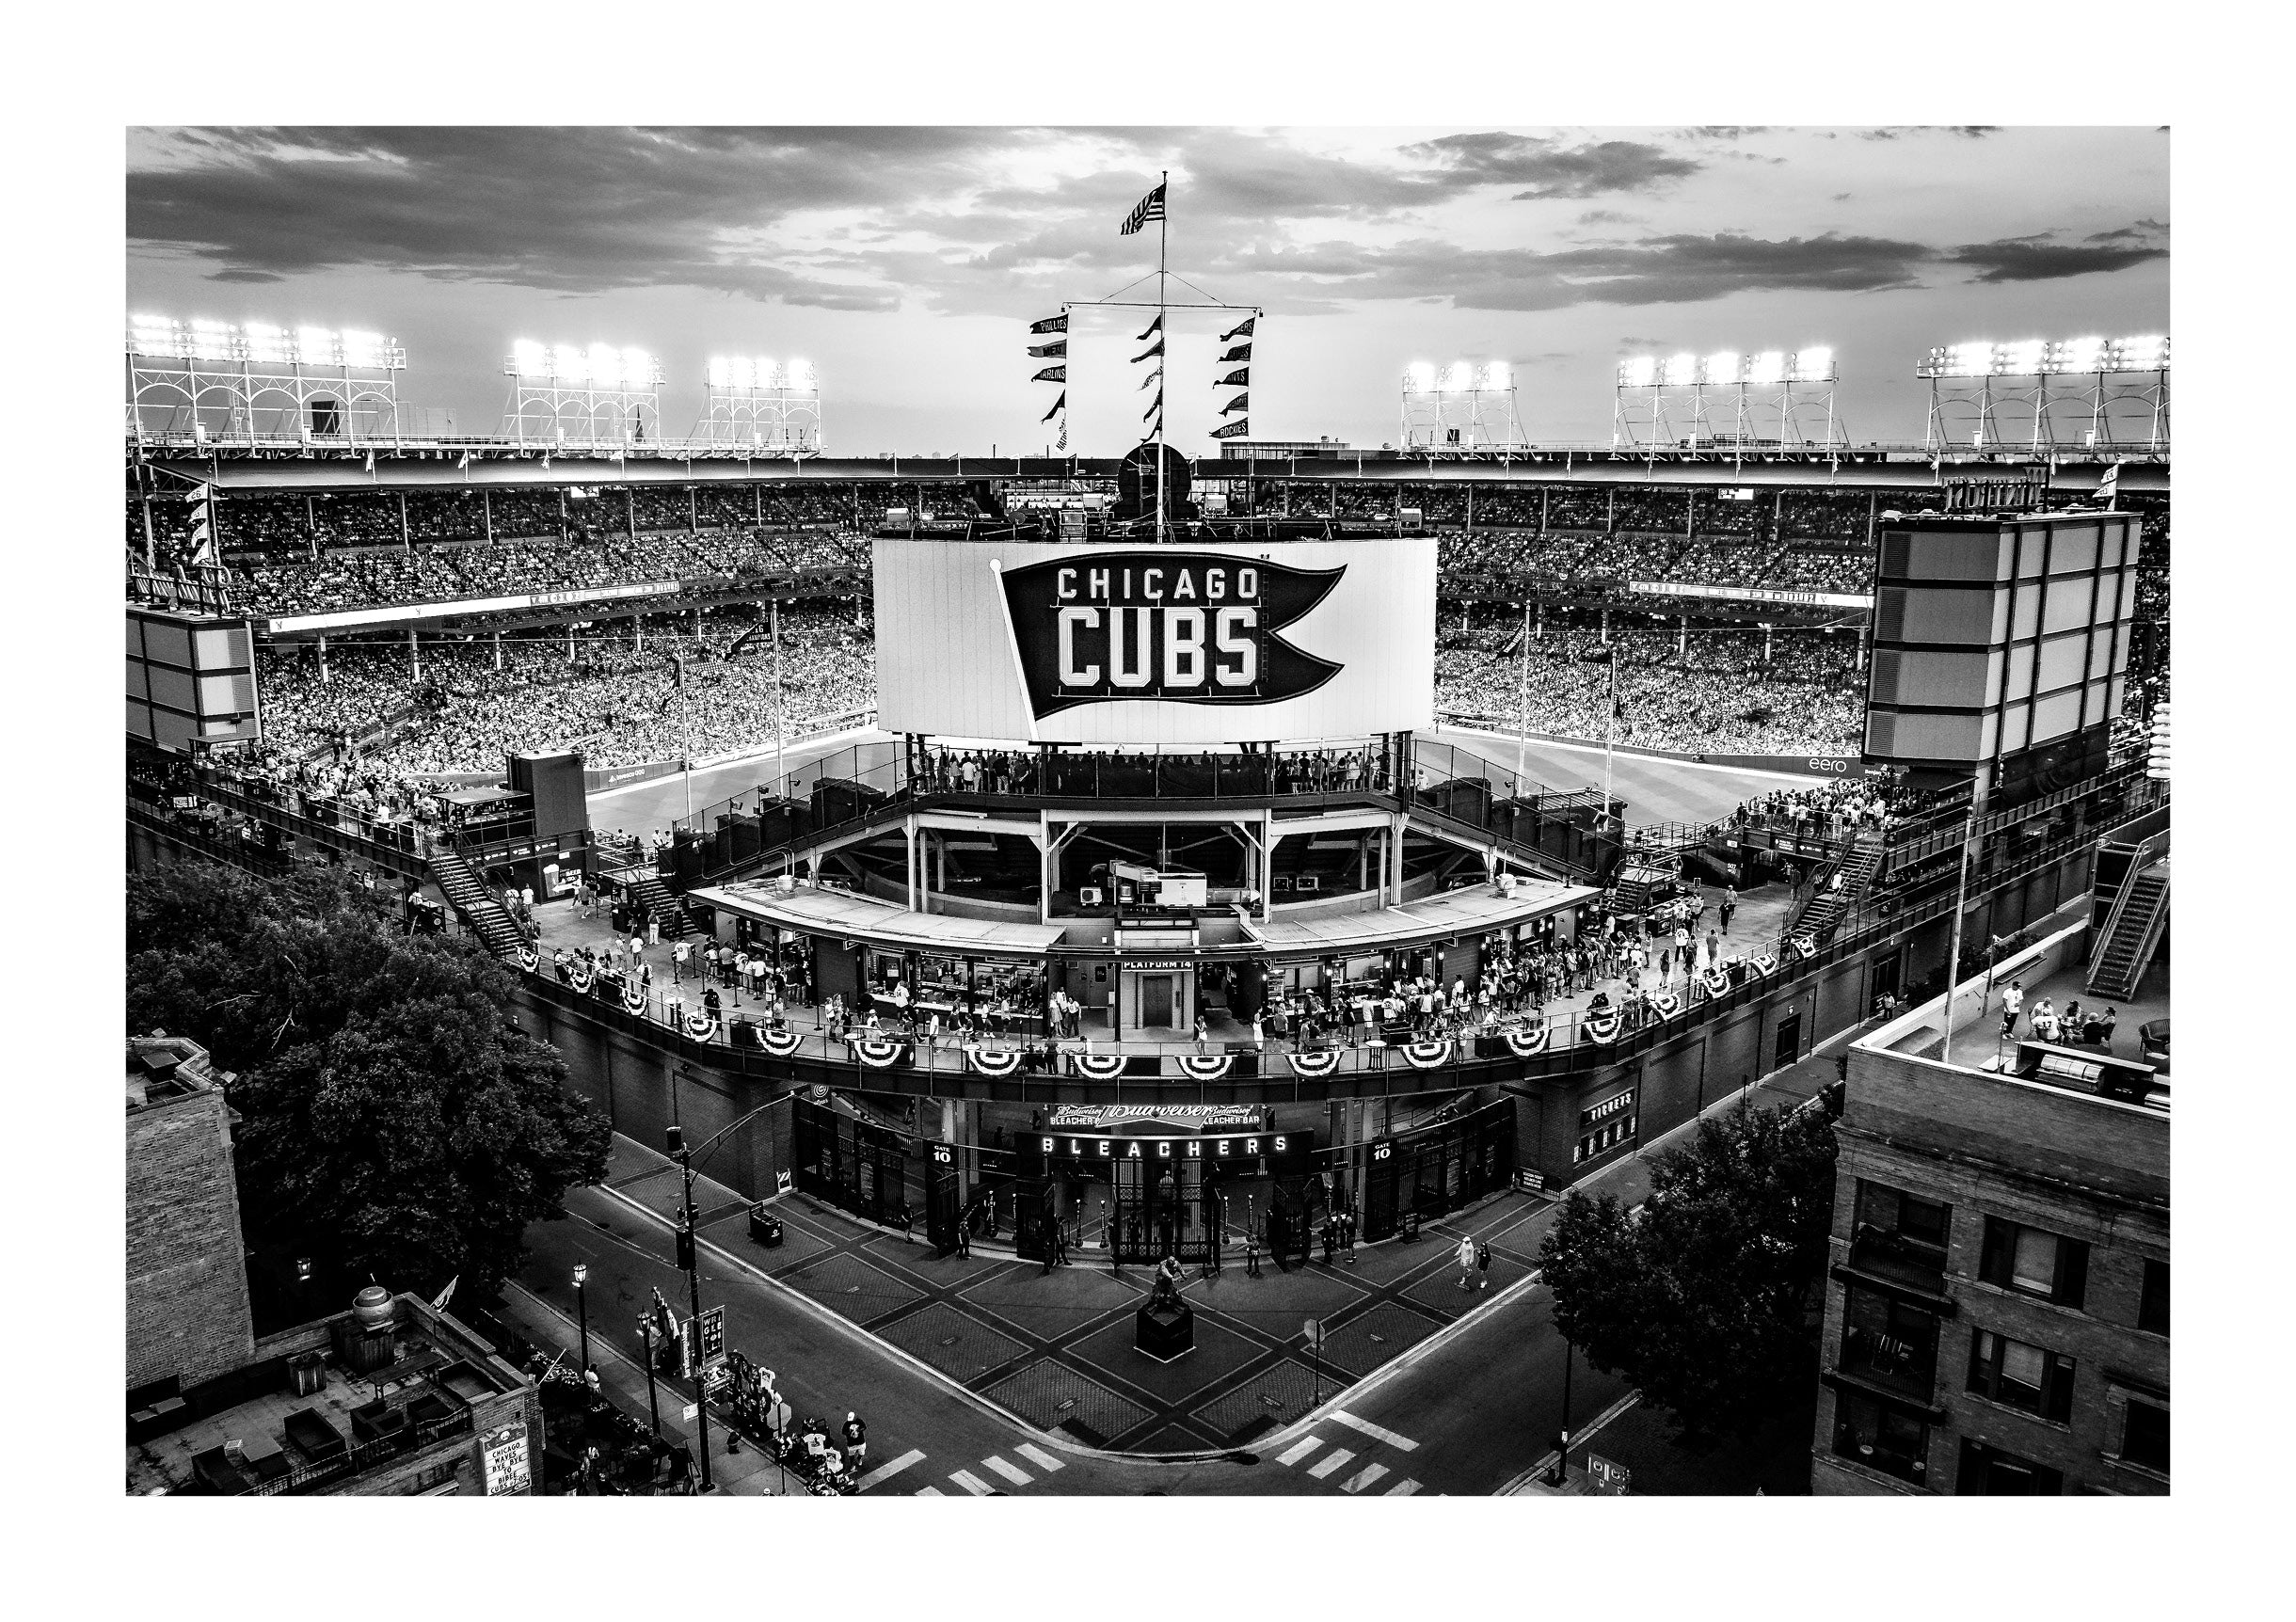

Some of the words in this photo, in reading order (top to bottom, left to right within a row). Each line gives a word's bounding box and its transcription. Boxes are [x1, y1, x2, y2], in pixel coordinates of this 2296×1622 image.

[1220, 421, 1247, 437] ROCKIES
[1058, 568, 1257, 599] CHICAGO
[1059, 607, 1257, 688] CUBS
[1809, 757, 1847, 772] eero
[1590, 1092, 1632, 1121] TICKETS
[1049, 1117, 1092, 1125] BLEACHER
[1204, 1117, 1241, 1125] LEACHER
[1242, 1115, 1260, 1124] BAR
[1042, 1136, 1286, 1157] BLEACHERS
[1374, 1141, 1391, 1150] GATE
[933, 1151, 951, 1163] 10
[1374, 1148, 1391, 1161] 10
[492, 1441, 520, 1458] CHICAGO
[492, 1462, 505, 1473] BYE
[510, 1455, 522, 1466] BYE
[494, 1450, 517, 1465] WAVES
[498, 1471, 518, 1485] BIBEE
[503, 1467, 512, 1475] TO
[490, 1482, 508, 1494] CUBS
